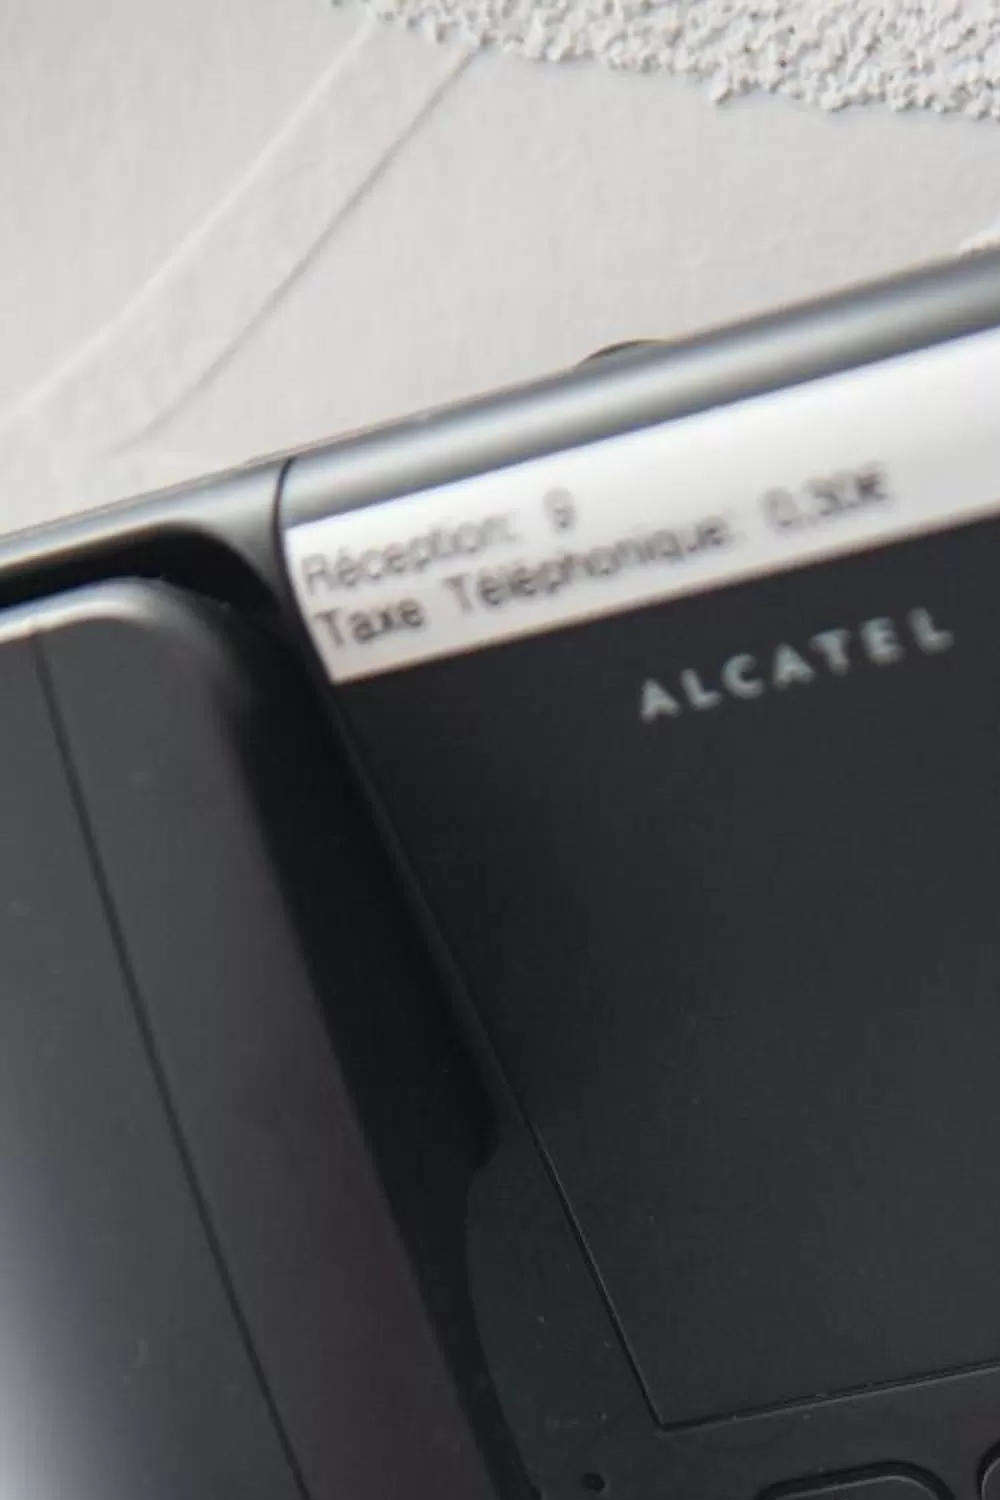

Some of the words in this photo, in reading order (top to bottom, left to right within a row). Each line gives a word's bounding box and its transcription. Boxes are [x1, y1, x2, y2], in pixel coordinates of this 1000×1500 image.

[544, 488, 576, 534] 9
[314, 597, 427, 650] Taxe
[640, 607, 953, 722] ALCATEL
